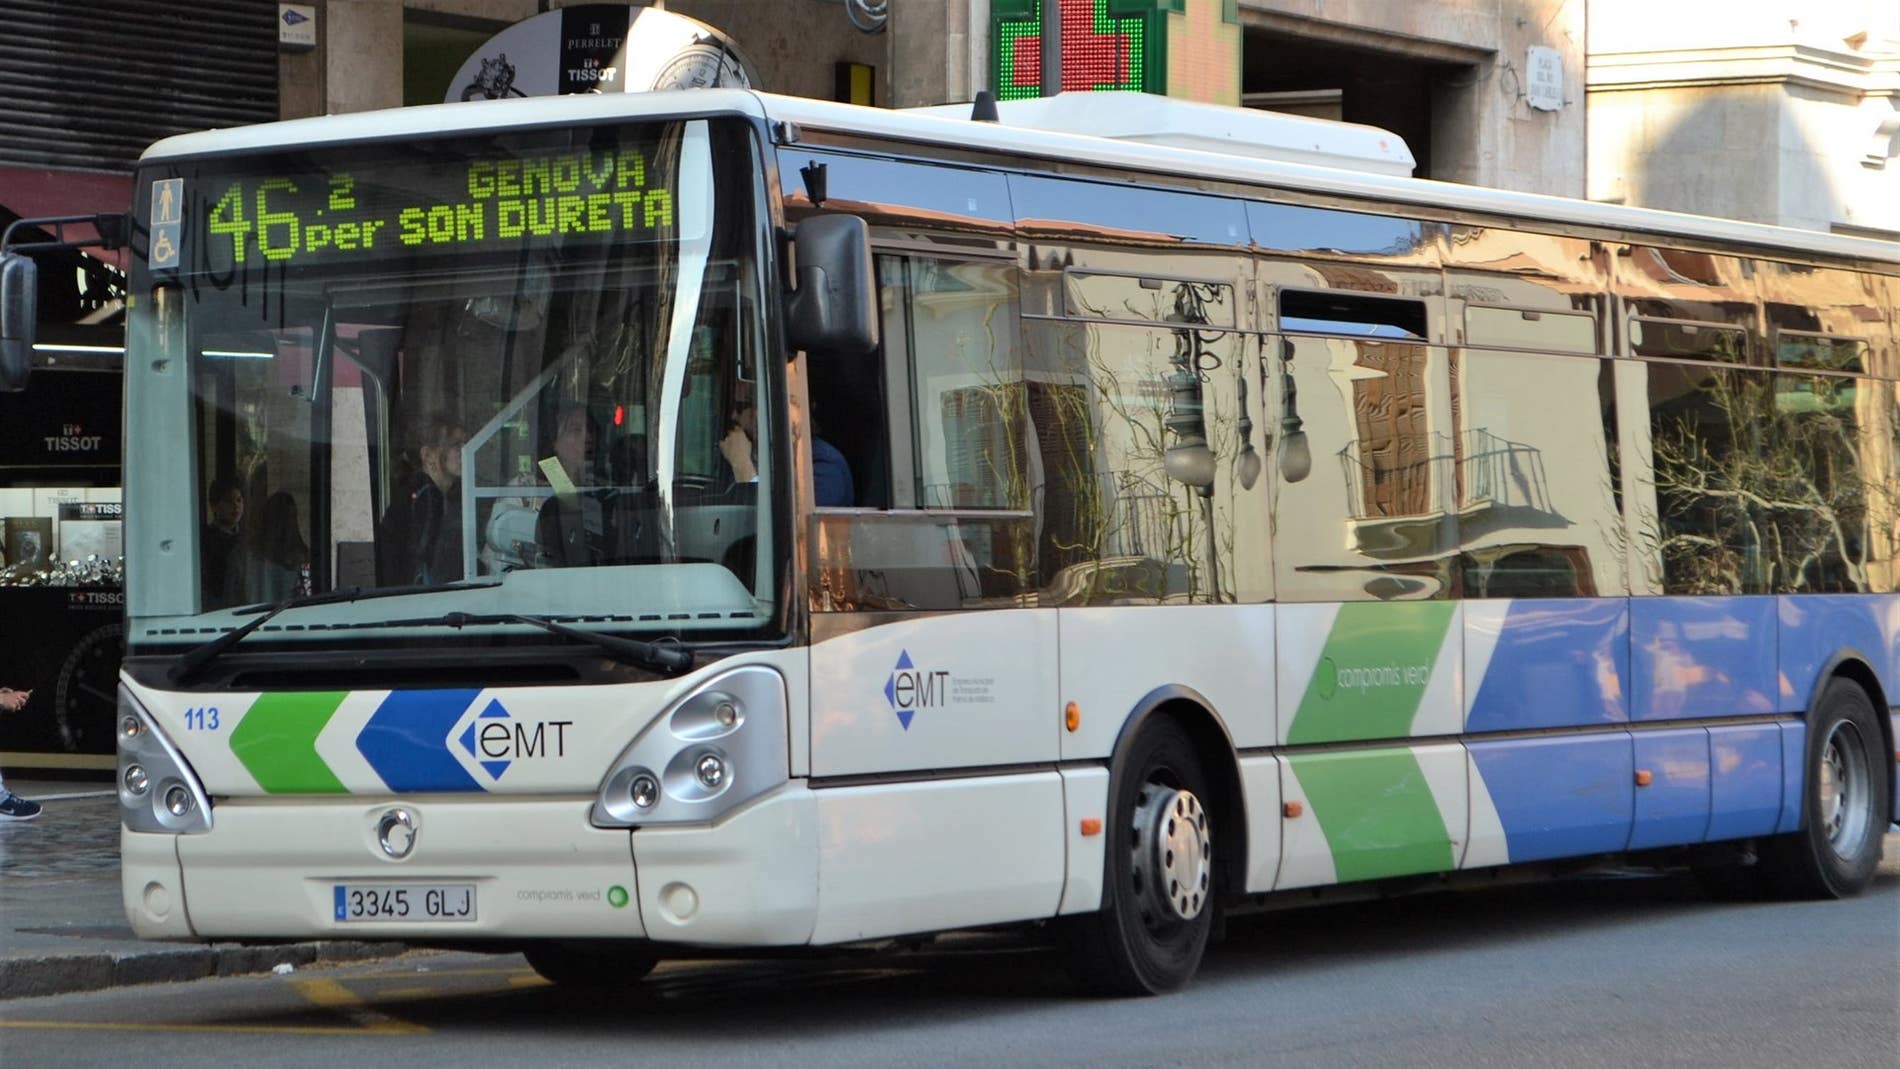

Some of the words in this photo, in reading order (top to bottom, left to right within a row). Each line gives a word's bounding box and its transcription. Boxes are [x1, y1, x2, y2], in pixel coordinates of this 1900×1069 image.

[568, 37, 621, 50] PERRELET
[568, 67, 617, 82] TISSOT
[467, 150, 646, 199] GENOVA
[209, 177, 300, 263] 46
[306, 219, 385, 253] per
[399, 202, 484, 246] SON
[498, 187, 673, 239] DURETA
[44, 437, 101, 450] TISSOT
[87, 592, 124, 604] TISSO
[184, 707, 220, 731] 113
[351, 889, 410, 917] 3345
[425, 889, 471, 917] GLJ
